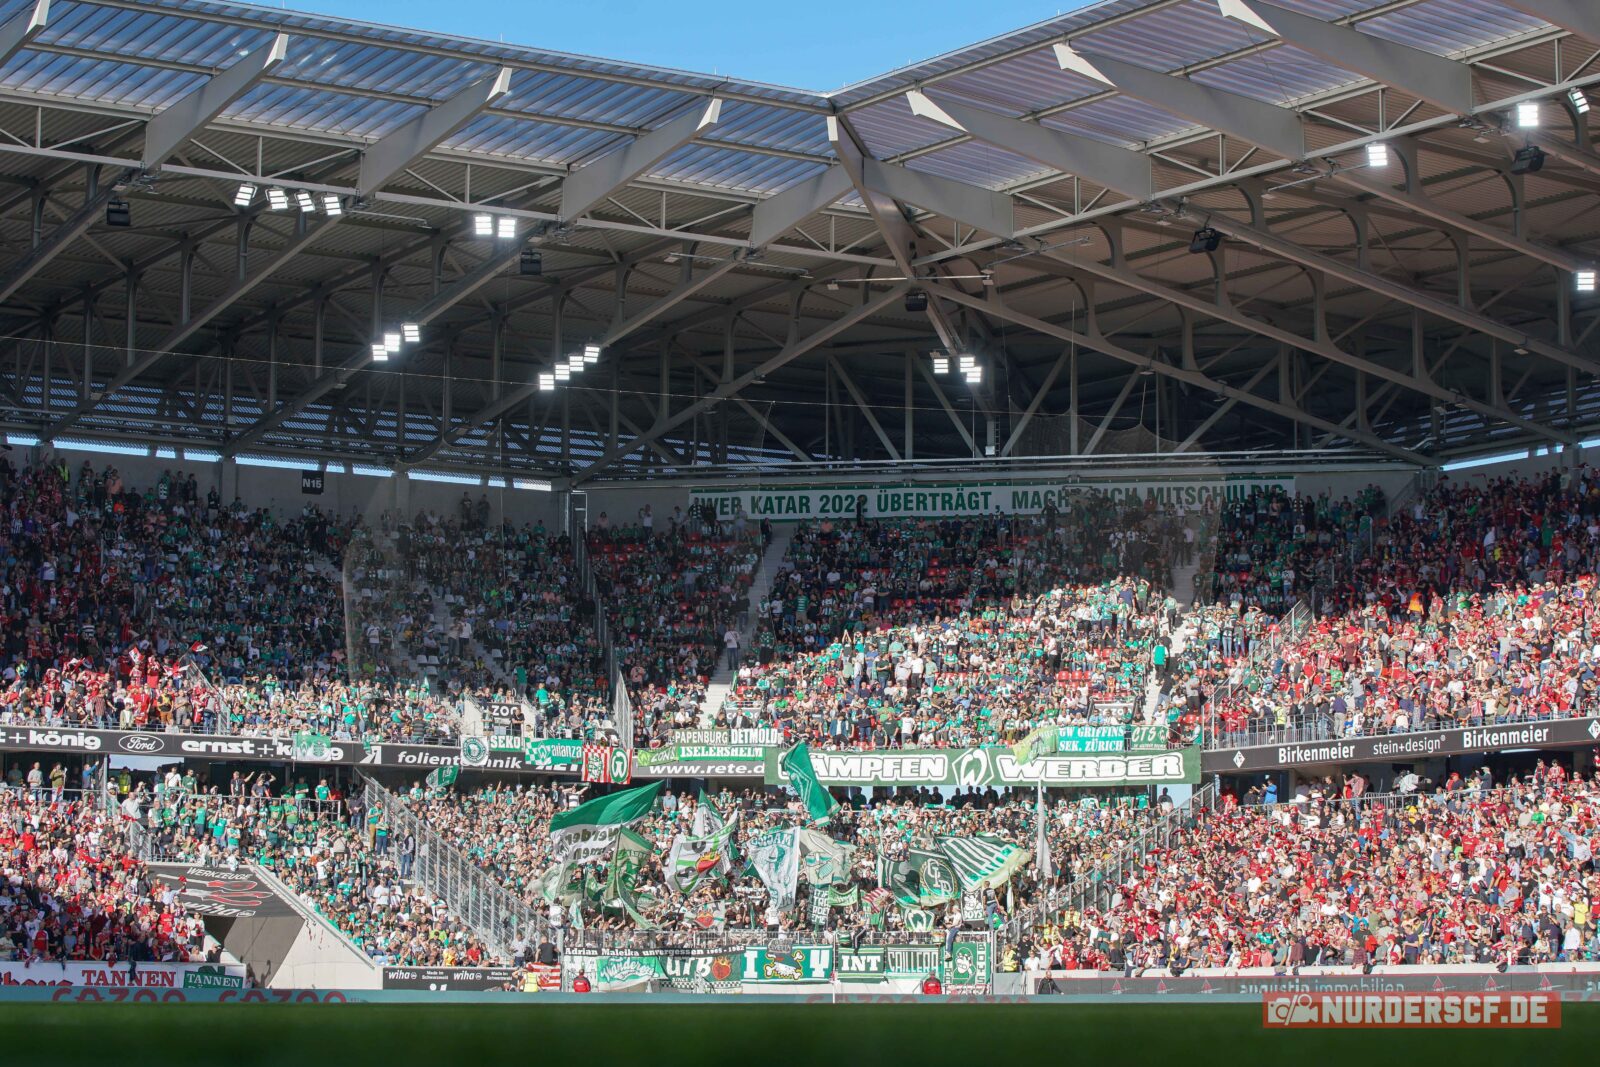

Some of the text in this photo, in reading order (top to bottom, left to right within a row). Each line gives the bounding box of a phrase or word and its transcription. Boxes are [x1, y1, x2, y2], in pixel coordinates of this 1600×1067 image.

[750, 494, 812, 515] KATAR
[675, 730, 729, 745] PAPENBURG
[731, 728, 778, 745] DETMOLD
[1077, 725, 1125, 738] GRIFFINS
[1463, 725, 1549, 749] Birkenmeier
[29, 729, 101, 750] könig
[126, 736, 156, 751] Ford
[181, 740, 255, 754] ernst
[1058, 740, 1080, 752] SEK.
[1085, 738, 1124, 752] ZÜRICH
[398, 750, 523, 769] folientnik
[680, 746, 763, 758] ISELERSHEIM
[1278, 743, 1356, 764] Birkenmeier
[997, 752, 1184, 782] WERDER
[186, 866, 254, 881] WERKZEUGE
[565, 947, 599, 955] Adrian
[642, 949, 704, 957] unvergessen
[841, 955, 881, 972] INT
[887, 951, 938, 973] CAILLERA
[81, 969, 176, 987] TANNEN
[187, 973, 241, 988] TANNEN
[388, 970, 411, 980] wiha
[453, 970, 475, 980] wiha
